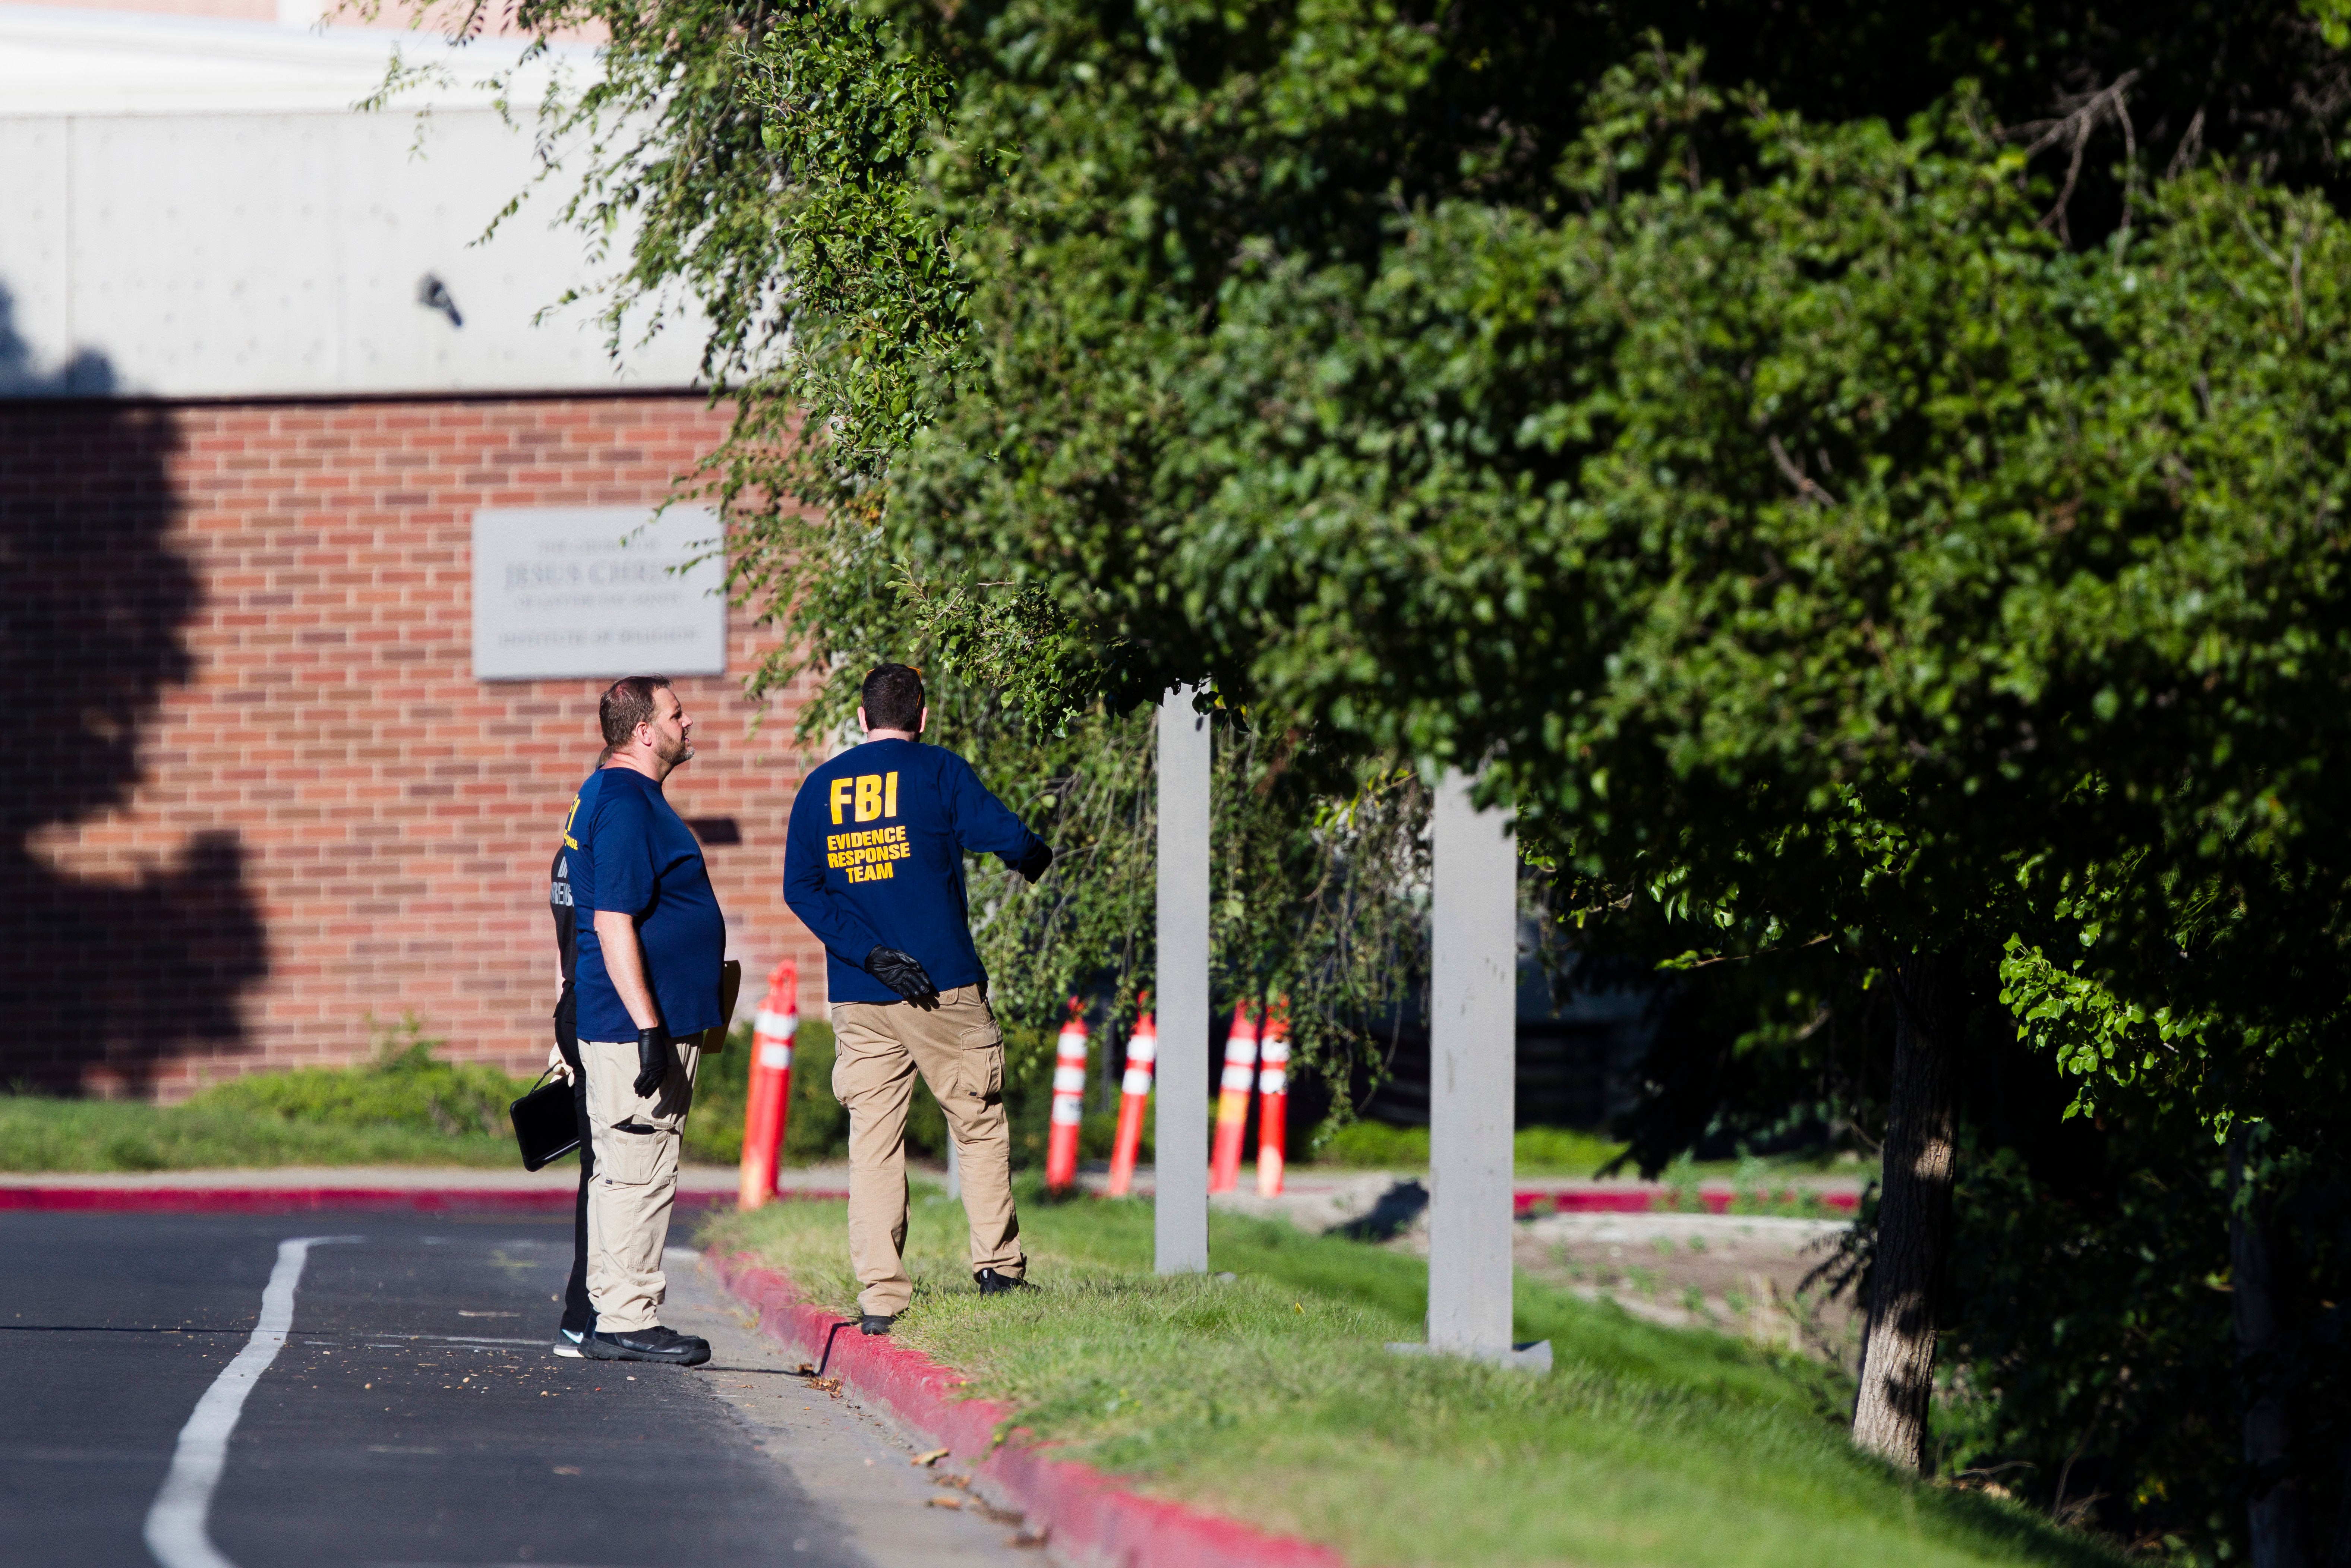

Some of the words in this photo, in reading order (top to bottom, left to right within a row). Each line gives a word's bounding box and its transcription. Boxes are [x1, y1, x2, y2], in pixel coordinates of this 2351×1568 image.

[830, 771, 898, 825] FBI
[827, 826, 906, 851] EVIDENCE
[827, 842, 911, 868] RESPONSE
[845, 862, 894, 883] TEAM
